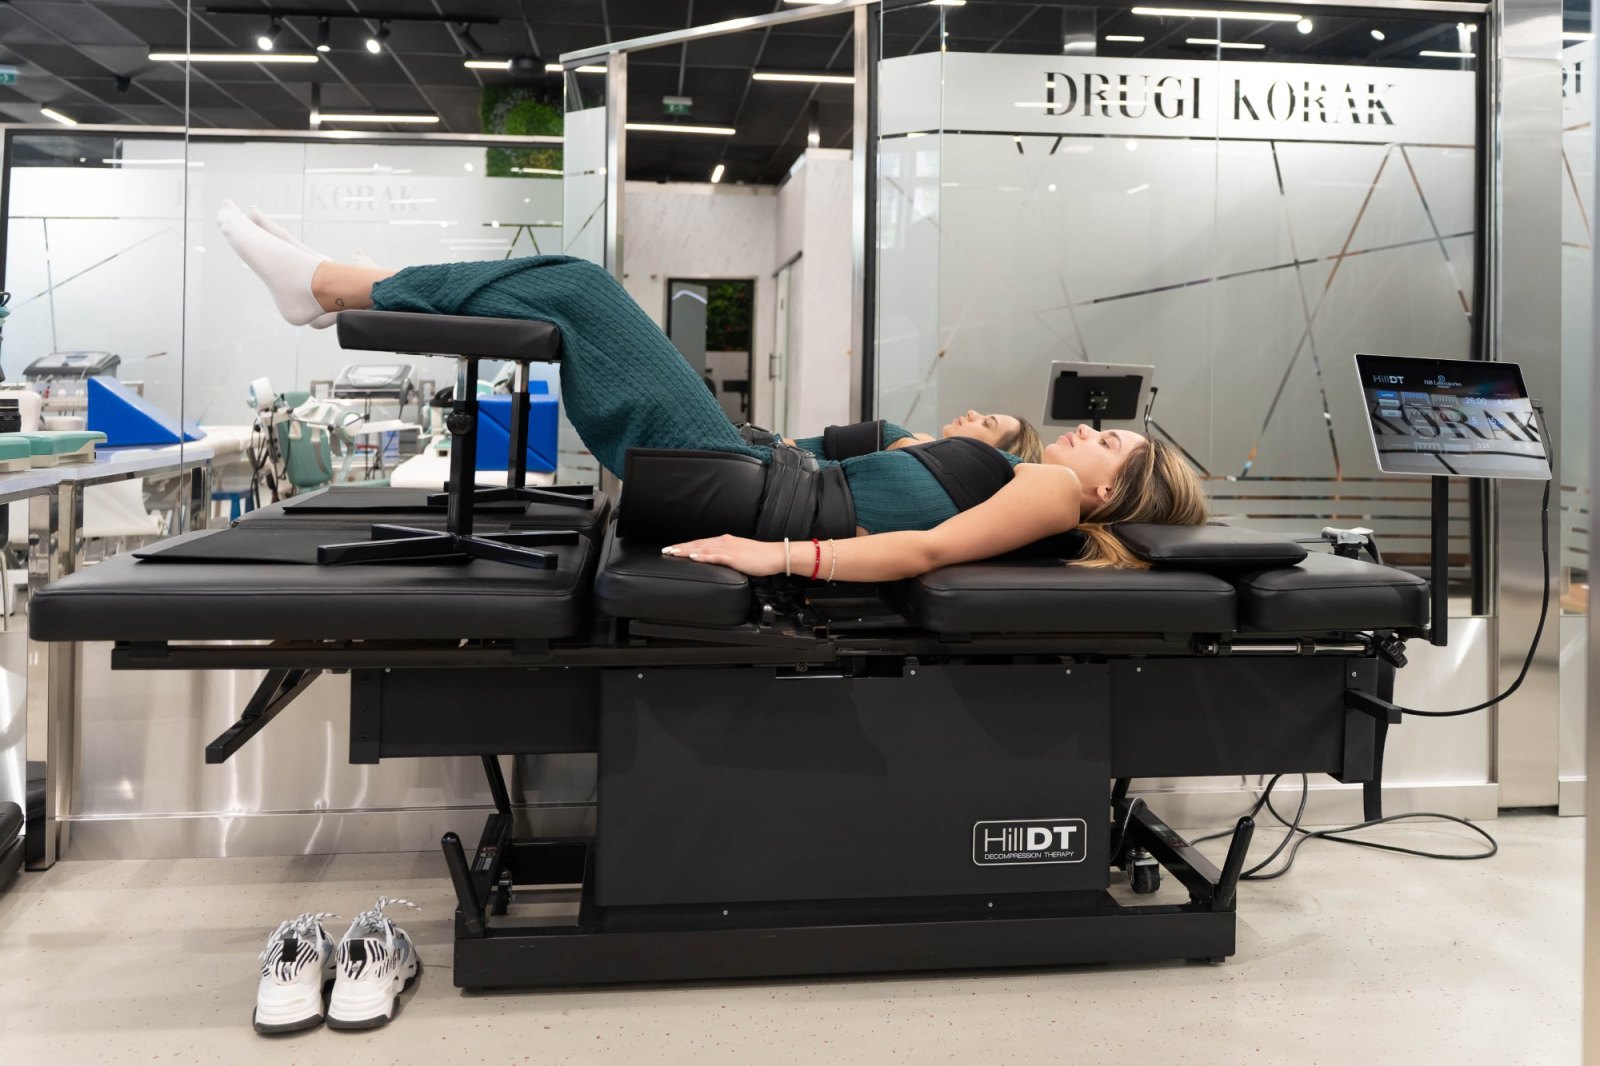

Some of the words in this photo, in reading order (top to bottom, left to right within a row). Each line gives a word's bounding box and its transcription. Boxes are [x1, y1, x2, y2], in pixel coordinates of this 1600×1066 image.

[1044, 72, 1202, 119] DRUGI
[1233, 79, 1396, 125] KORAK
[1372, 375, 1404, 384] HillDT
[984, 826, 1077, 852] HillDT
[984, 852, 1041, 860] DECOMPRESSION
